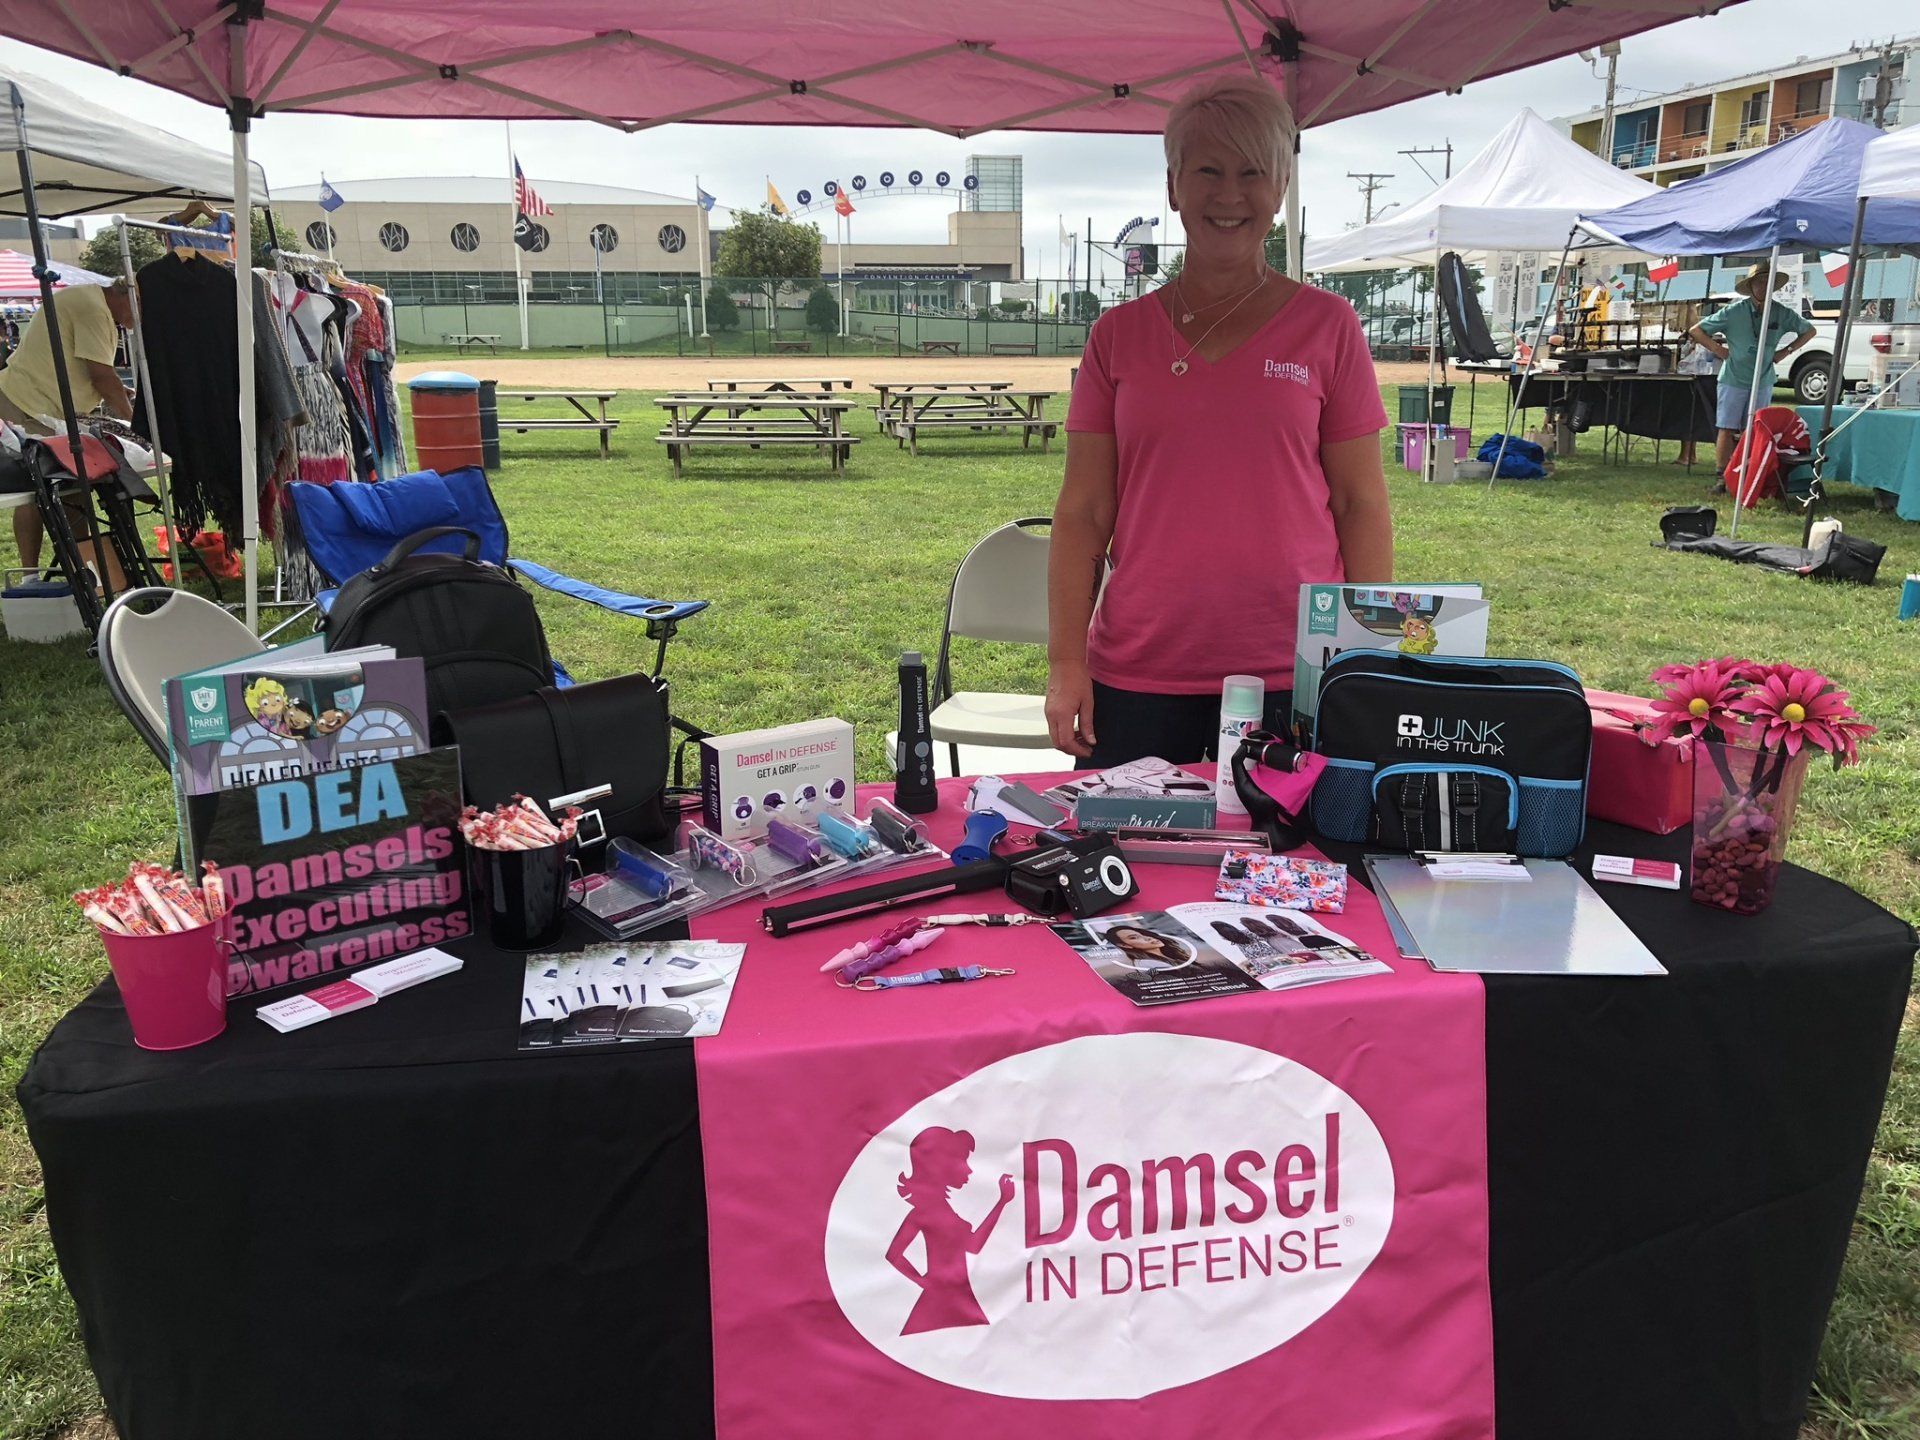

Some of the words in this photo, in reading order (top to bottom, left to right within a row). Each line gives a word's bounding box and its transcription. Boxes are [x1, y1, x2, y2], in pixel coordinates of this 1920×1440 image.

[1264, 359, 1309, 380] Damsel
[194, 716, 224, 728] PARENT
[917, 712, 925, 734] Damsel
[1422, 717, 1505, 744] JUNK
[737, 749, 773, 767] Damsel
[776, 749, 787, 760] IN
[789, 740, 838, 758] DEFENSE
[757, 767, 771, 779] GET
[771, 767, 778, 776] A
[778, 763, 797, 775] GRIP
[256, 762, 408, 846] DEA
[710, 792, 719, 819] GRIP
[217, 825, 454, 906] Damsels
[228, 869, 462, 954] Executing
[890, 973, 923, 984] Damsel
[1022, 1112, 1340, 1249] Damsel
[1026, 1255, 1077, 1303] IN
[1101, 1224, 1342, 1296] DEFENSE
